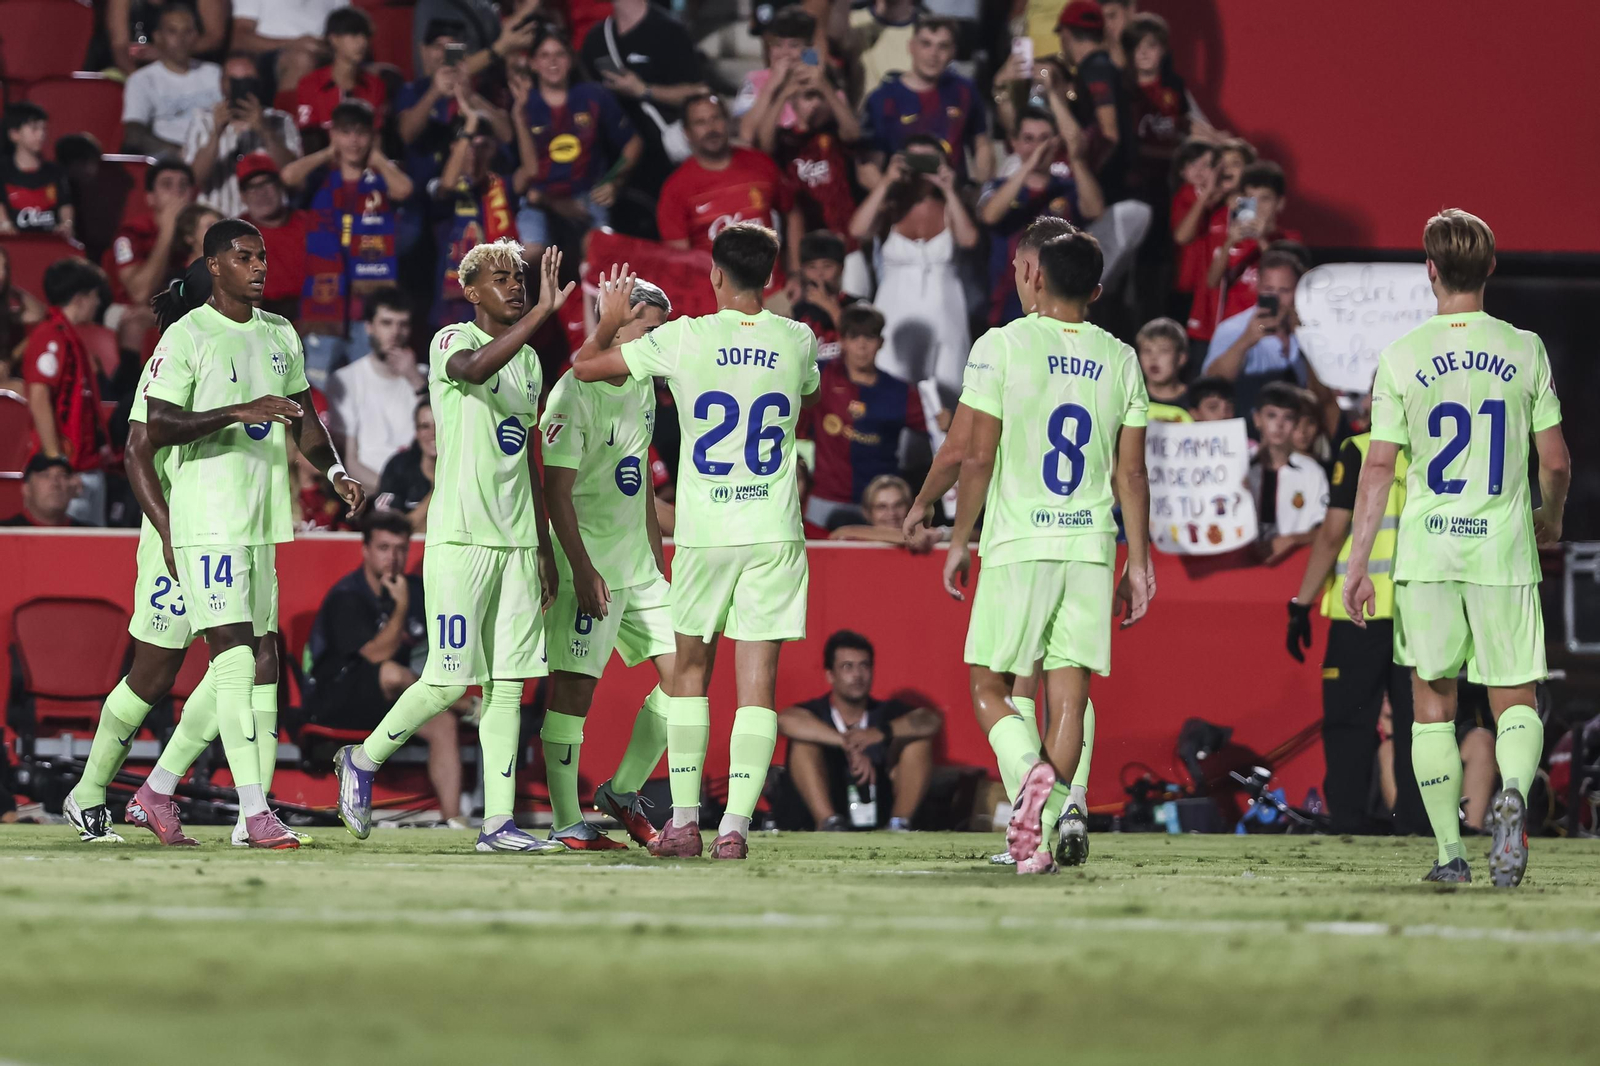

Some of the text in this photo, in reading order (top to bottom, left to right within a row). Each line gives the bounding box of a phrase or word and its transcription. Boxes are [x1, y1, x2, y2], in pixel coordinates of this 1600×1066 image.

[716, 347, 779, 370] JOFRE
[1047, 355, 1103, 381] PEDRI
[693, 391, 790, 475] 26
[1043, 403, 1092, 496] 8
[1173, 436, 1236, 458] YAMAL
[1427, 399, 1506, 495] 21
[1058, 517, 1093, 525] ACNUR
[1450, 525, 1488, 535] ACNUR
[1451, 516, 1488, 526] UNHCR
[200, 554, 234, 589] 14
[436, 614, 466, 649] 10
